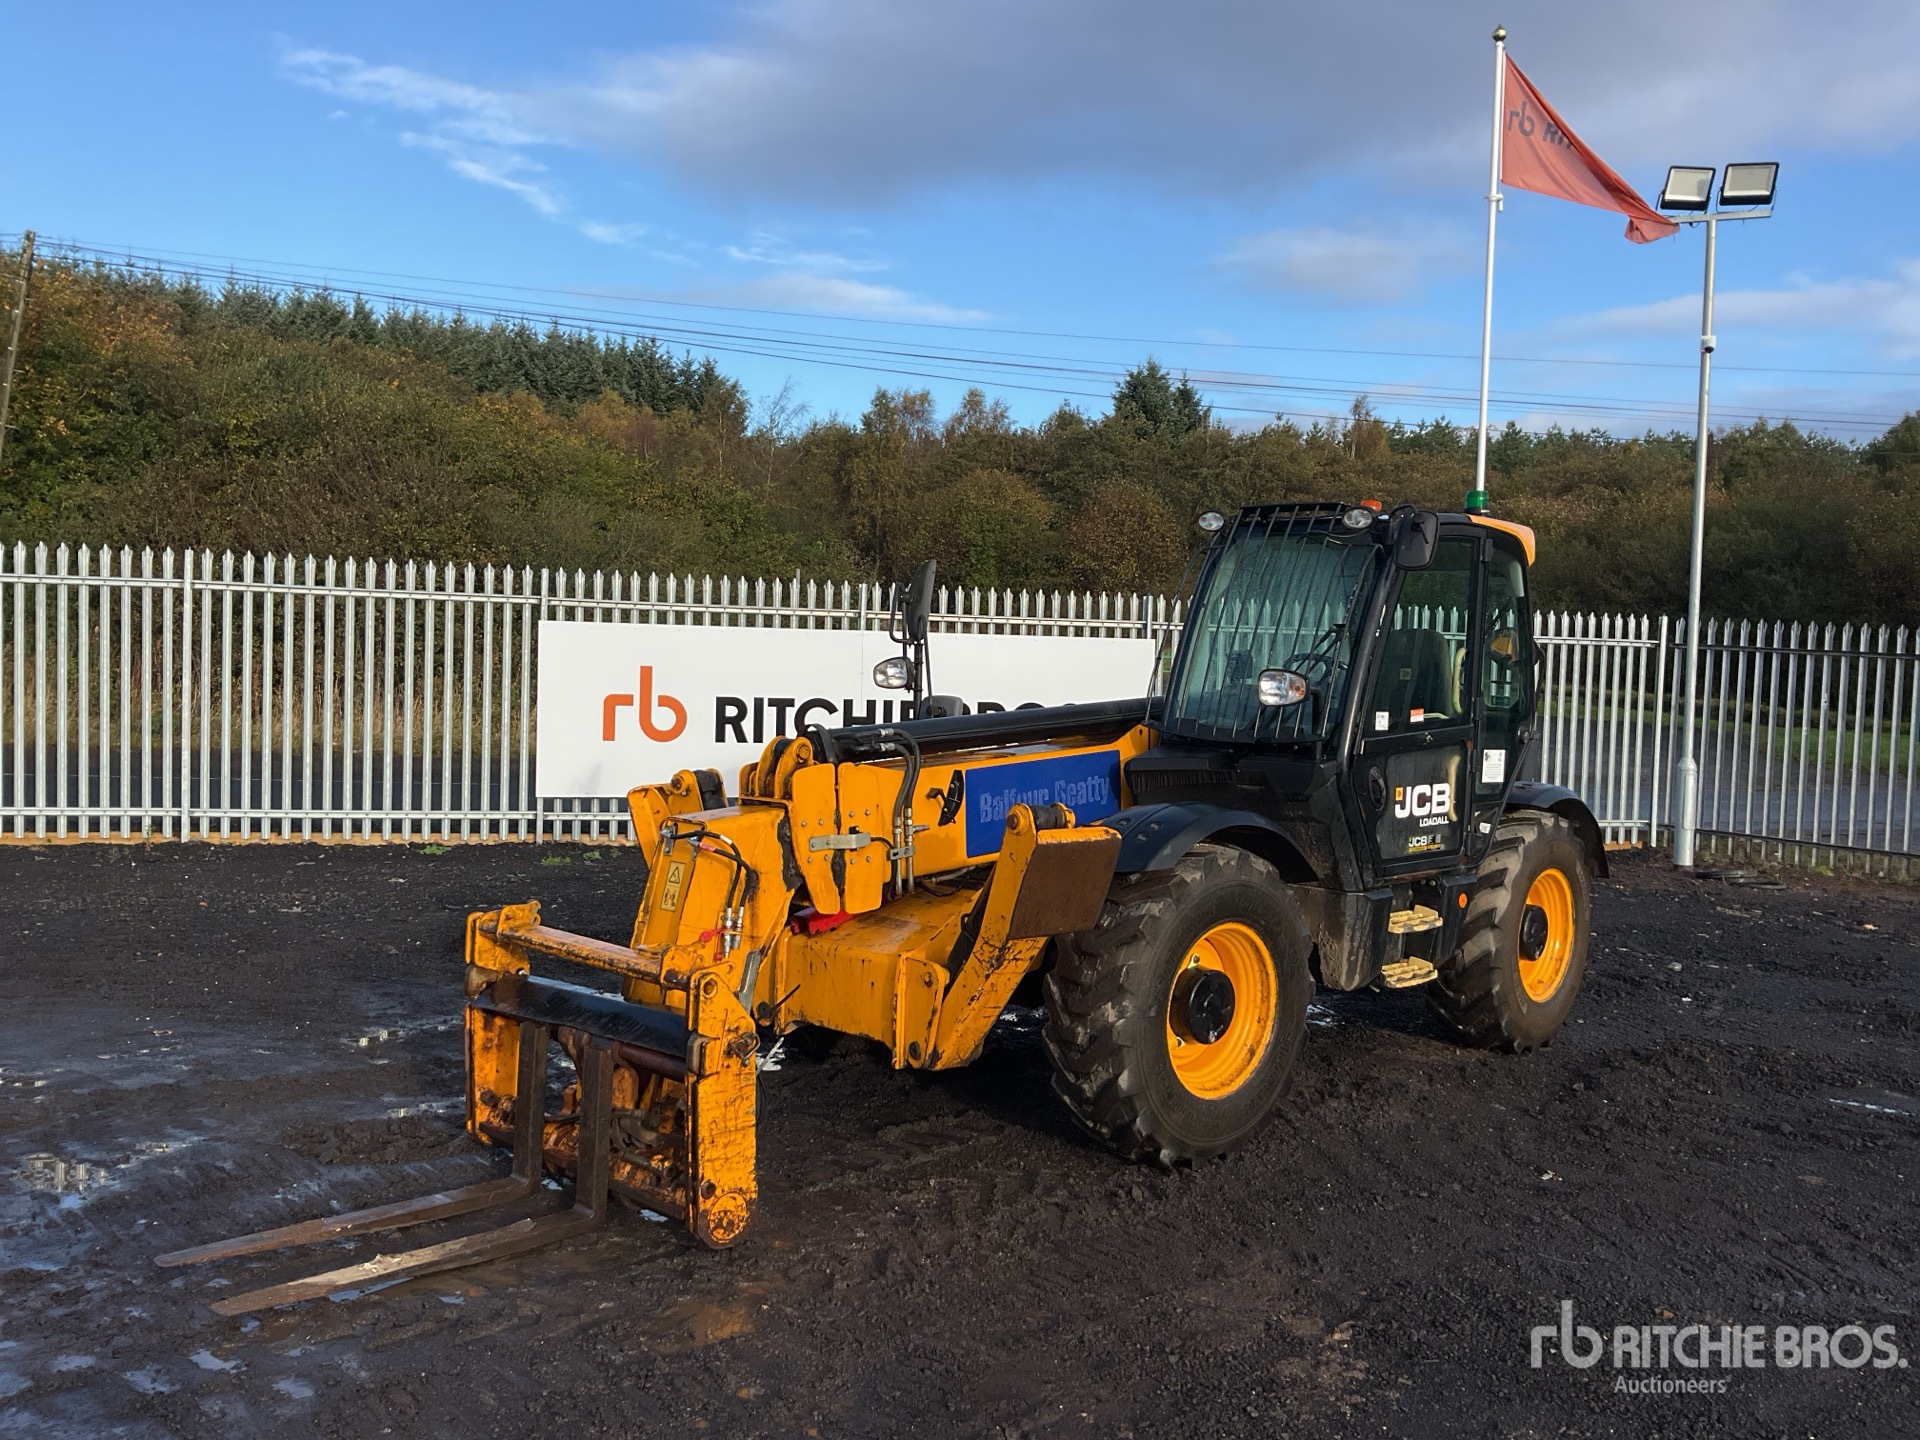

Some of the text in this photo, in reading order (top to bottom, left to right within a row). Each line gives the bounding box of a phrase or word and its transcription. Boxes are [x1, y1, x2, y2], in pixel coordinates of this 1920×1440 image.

[602, 665, 688, 743] rb
[1395, 783, 1451, 818] JCB
[1419, 816, 1449, 827] LOADALL
